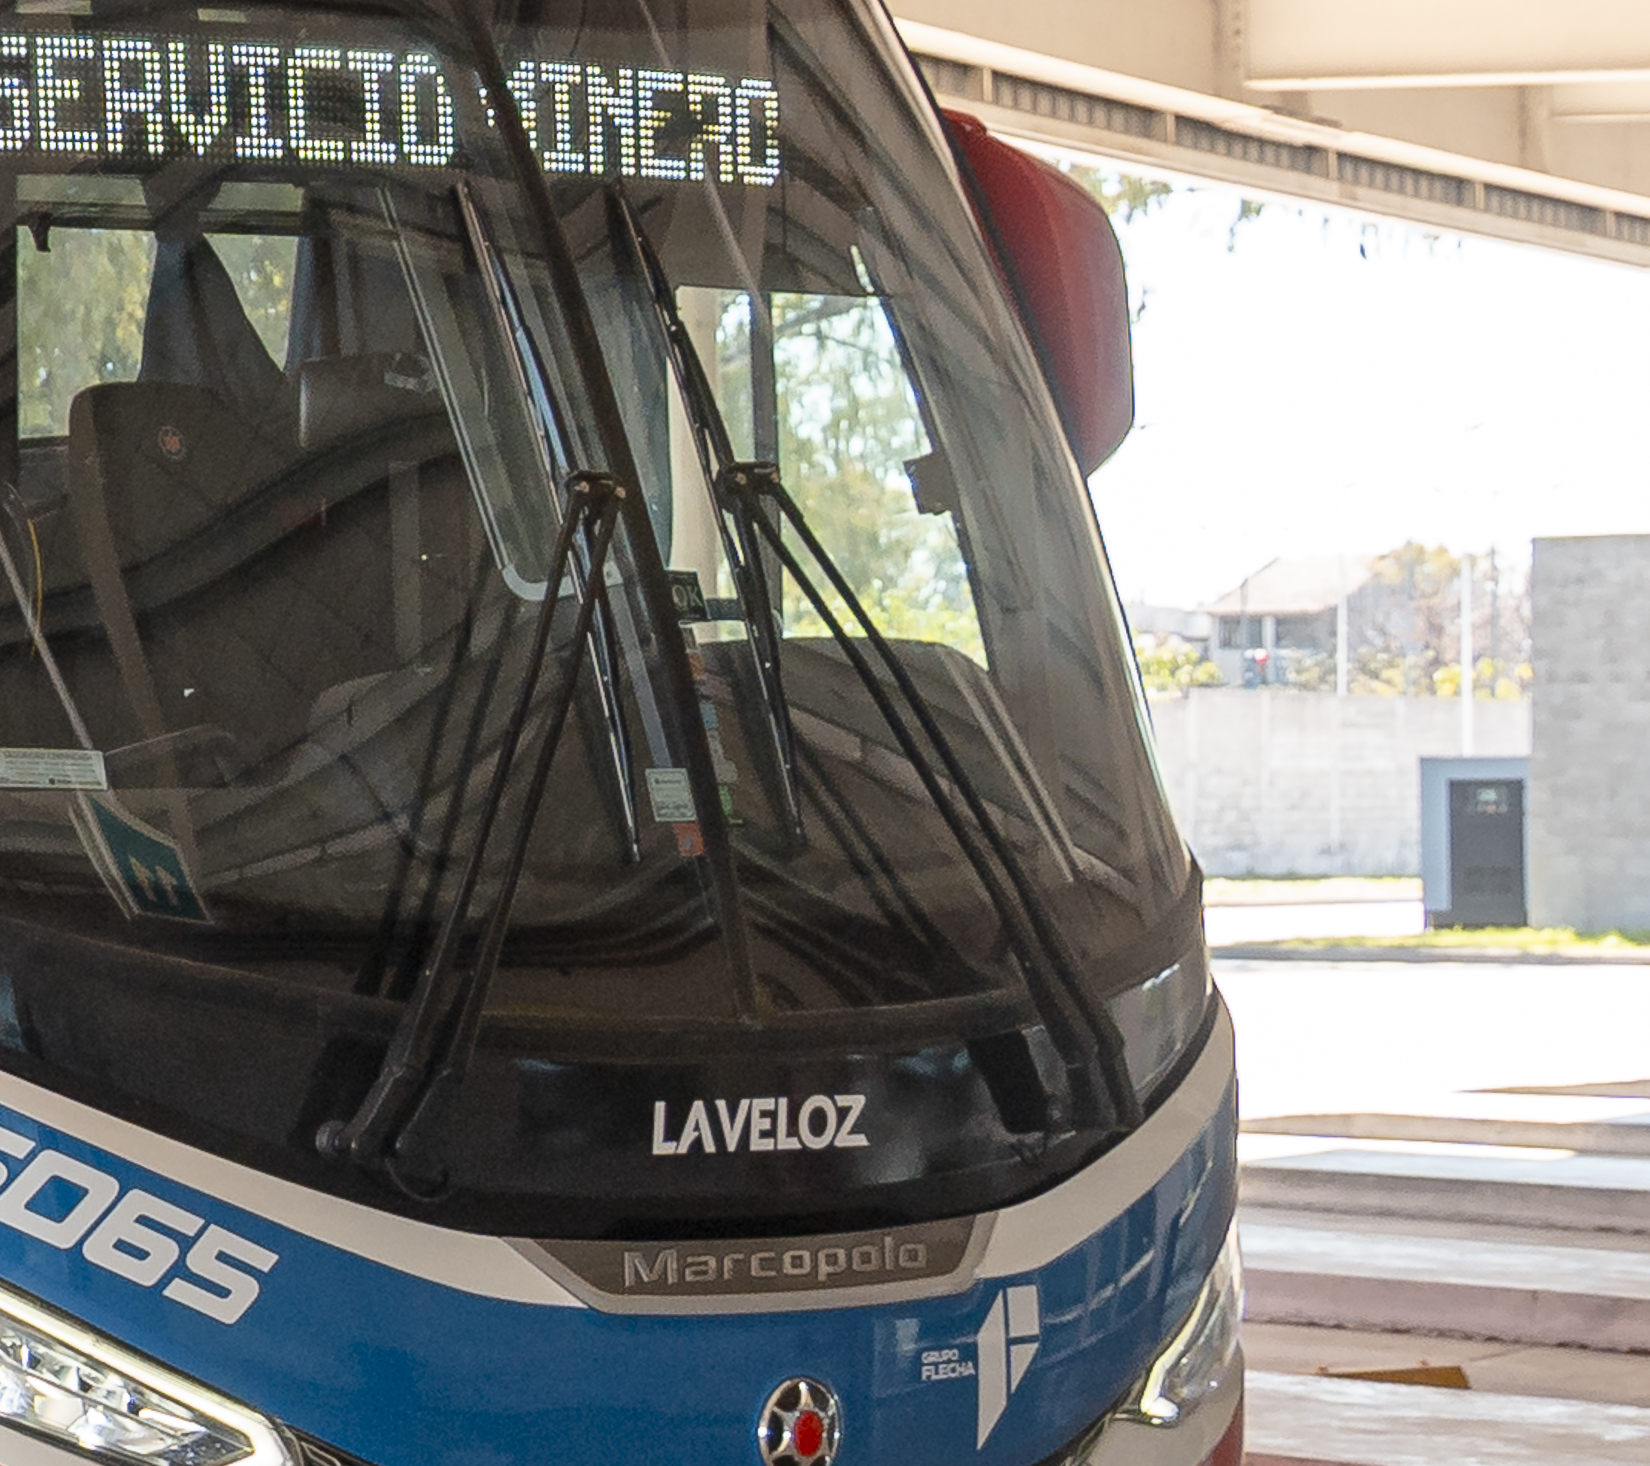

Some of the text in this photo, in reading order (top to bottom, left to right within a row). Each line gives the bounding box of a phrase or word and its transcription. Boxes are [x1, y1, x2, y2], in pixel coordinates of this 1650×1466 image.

[623, 1236, 928, 1289] Marcopolo
[920, 1348, 960, 1365] GRUPO
[920, 1361, 976, 1382] FLECHA
